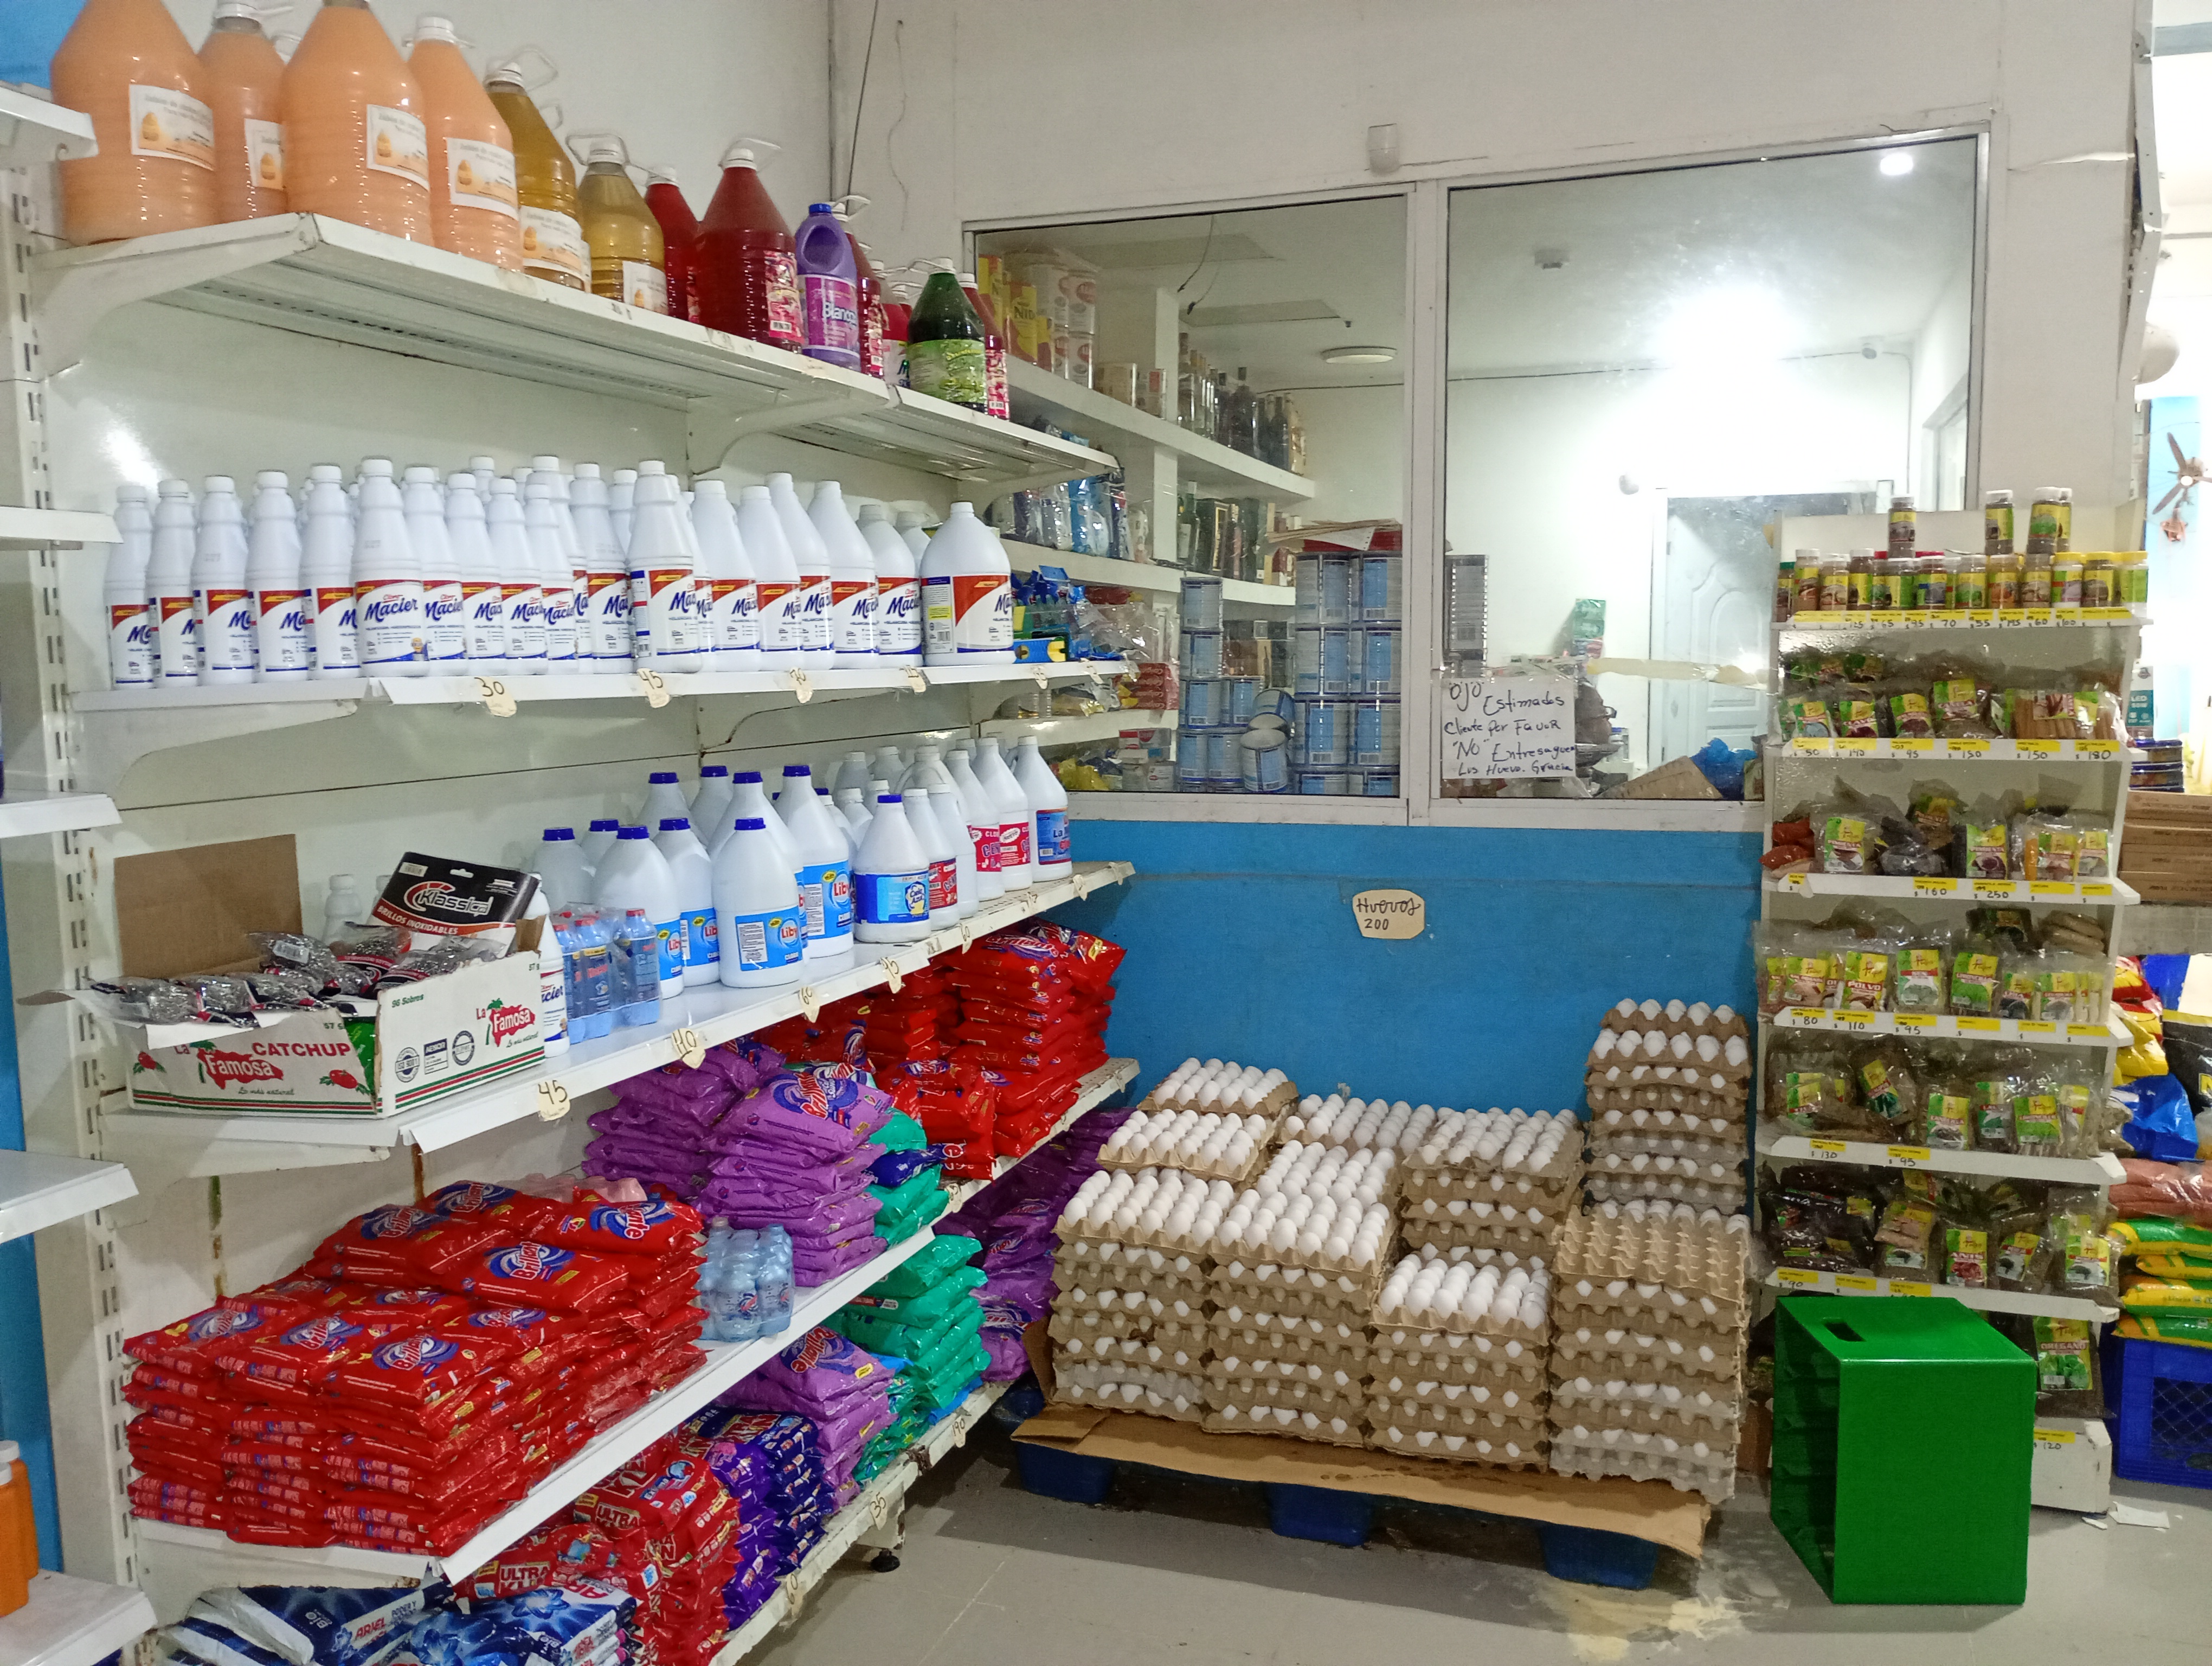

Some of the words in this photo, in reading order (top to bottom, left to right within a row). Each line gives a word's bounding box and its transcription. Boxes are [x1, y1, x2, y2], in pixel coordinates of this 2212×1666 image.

[364, 597, 419, 621] Macier
[637, 670, 664, 690] 45
[474, 677, 505, 697] 30
[2028, 751, 2048, 760] 150
[2088, 749, 2112, 760] 180
[1925, 887, 1947, 896] 160
[1987, 890, 2009, 899] 250
[1356, 897, 1422, 916] Huevos
[377, 905, 407, 924] BRILLOS
[1364, 918, 1389, 931] 200
[1847, 980, 1882, 991] POLVO
[476, 1008, 486, 1020] La
[493, 1009, 531, 1033] Famosa
[1803, 1016, 1818, 1026] 80
[1849, 1021, 1865, 1030] 110
[1905, 1026, 1921, 1035] 95
[252, 1041, 351, 1058] CATCHUP
[204, 1054, 274, 1077] Famosa
[537, 1079, 569, 1105] 45
[1821, 1151, 1838, 1159] 130
[1900, 1157, 1916, 1167] 95
[952, 1418, 966, 1437] 190
[501, 1565, 550, 1581] ULTRA
